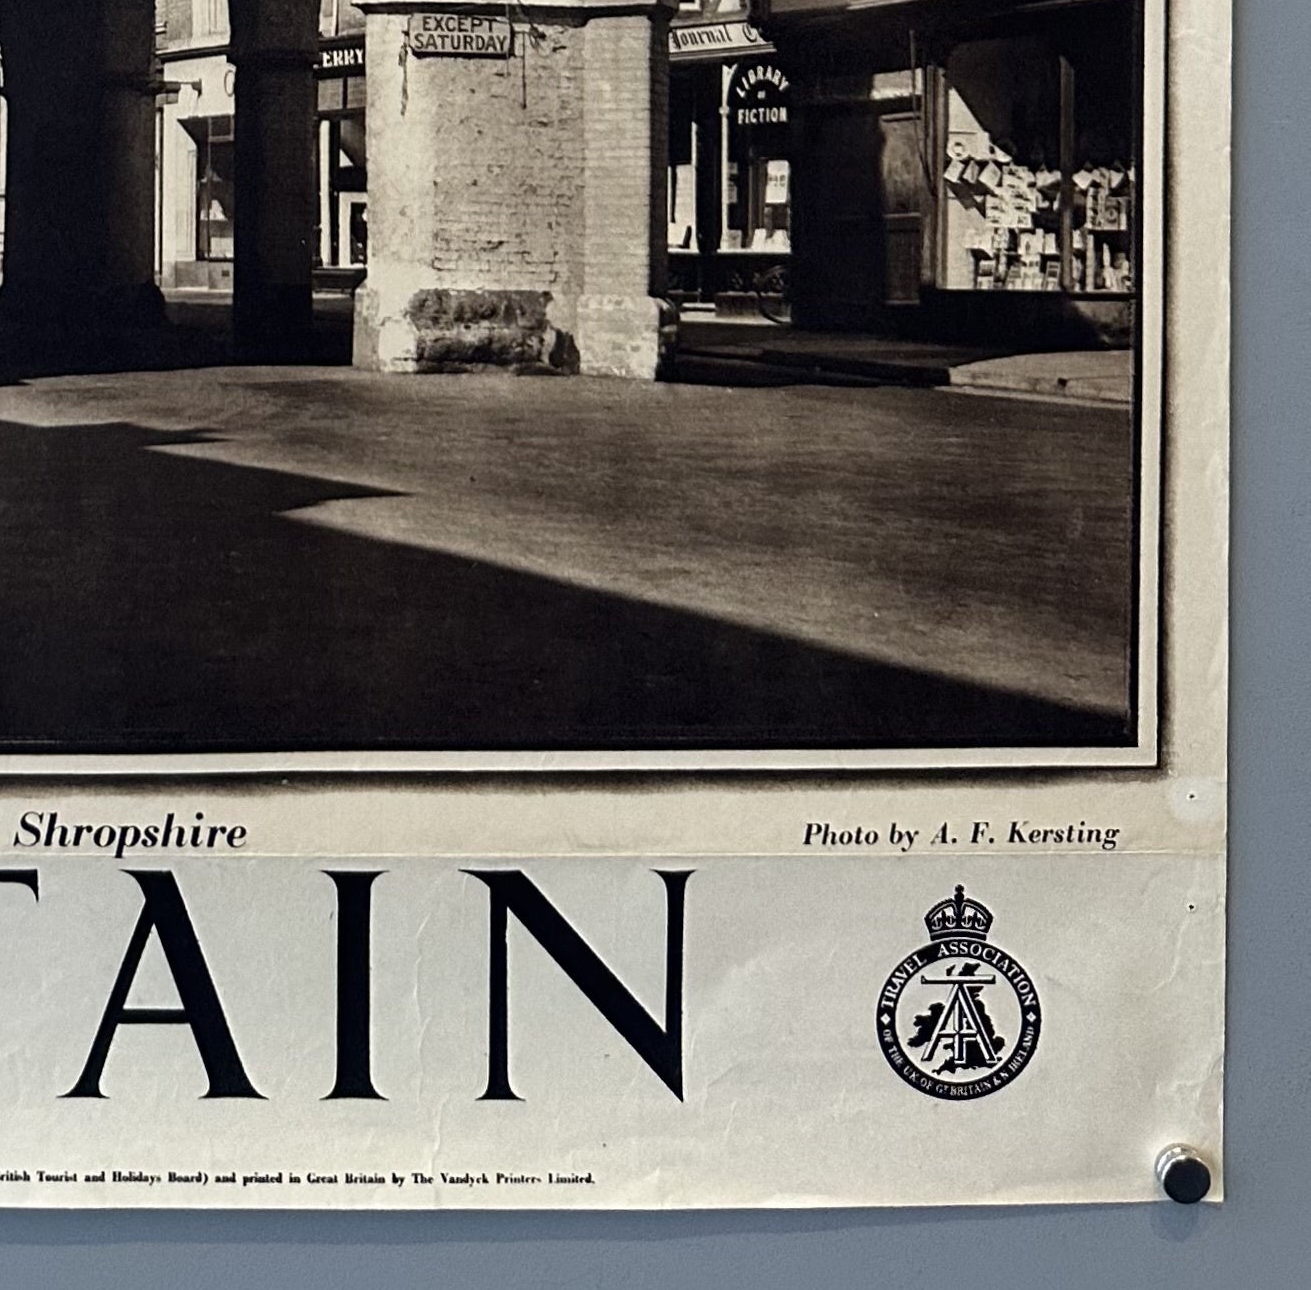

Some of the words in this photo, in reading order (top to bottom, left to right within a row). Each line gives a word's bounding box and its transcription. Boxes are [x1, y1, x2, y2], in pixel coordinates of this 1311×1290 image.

[422, 16, 495, 33] EXCEPT
[414, 33, 508, 52] SATURDAY
[313, 48, 364, 69] ERRY
[736, 65, 789, 98] LIBRARY
[738, 107, 788, 124] FICTION
[12, 812, 247, 858] Shropshire
[802, 822, 879, 846] Photo
[889, 822, 920, 852] by
[930, 821, 957, 845] A.
[970, 821, 995, 845] F.
[1007, 820, 1121, 851] Kersting
[881, 953, 927, 1009] TRAVEL
[937, 941, 1037, 1007] ASSOCIATION
[883, 1029, 894, 1043] OF
[888, 1045, 905, 1068] THE
[1008, 1026, 1034, 1073] IRELAND
[920, 1077, 934, 1090] OF
[949, 1080, 992, 1097] BRITAIN
[35, 1170, 78, 1183] Tourist
[83, 1170, 106, 1183] and
[111, 1170, 162, 1187] Holidays
[167, 1170, 209, 1187] Board)
[214, 1171, 237, 1184] and
[242, 1171, 284, 1188] printed
[288, 1172, 302, 1185] in
[306, 1172, 339, 1185] Great
[344, 1172, 387, 1185] Britain
[391, 1171, 406, 1189] by
[410, 1172, 435, 1185] The
[439, 1172, 490, 1188] Vandyck
[495, 1172, 542, 1185] Printers
[547, 1172, 596, 1185] Limited.
